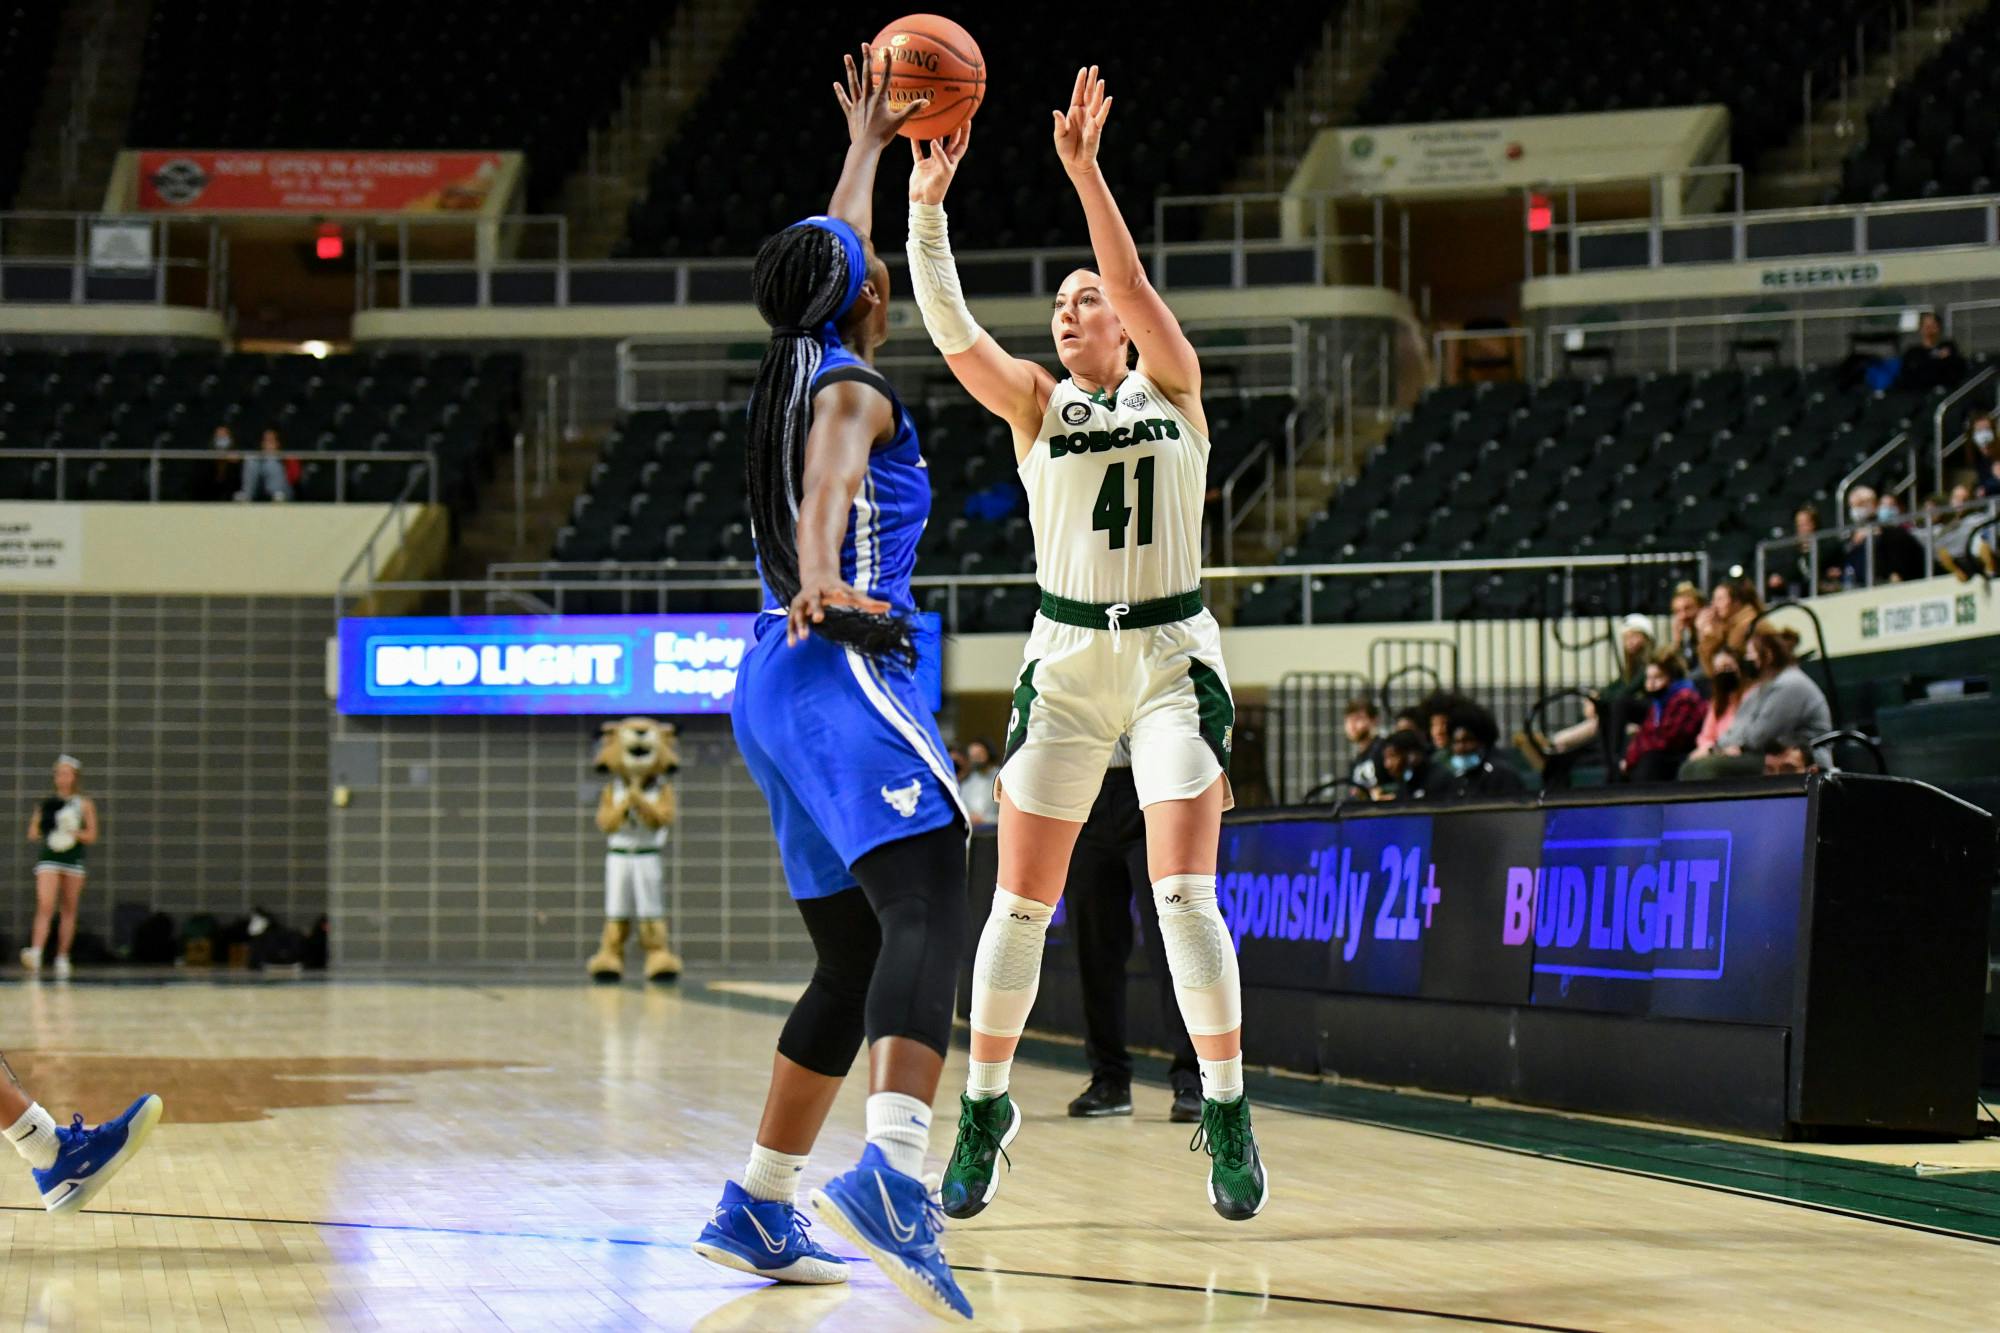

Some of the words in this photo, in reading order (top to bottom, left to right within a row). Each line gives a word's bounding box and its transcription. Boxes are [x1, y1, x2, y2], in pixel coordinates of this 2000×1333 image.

[896, 47, 940, 73] DING
[887, 87, 935, 102] 1000
[1762, 263, 1879, 287] RESERVED
[1049, 418, 1180, 459] BOBCATS
[1092, 456, 1155, 550] 41
[376, 645, 479, 686] BUD
[480, 644, 623, 686] LIGHT
[654, 631, 745, 668] Enjoy
[1216, 845, 1370, 961] sponsibly
[1374, 844, 1441, 940] 21+
[1502, 866, 1586, 949] BUD
[1588, 859, 1721, 954] LIGHT
